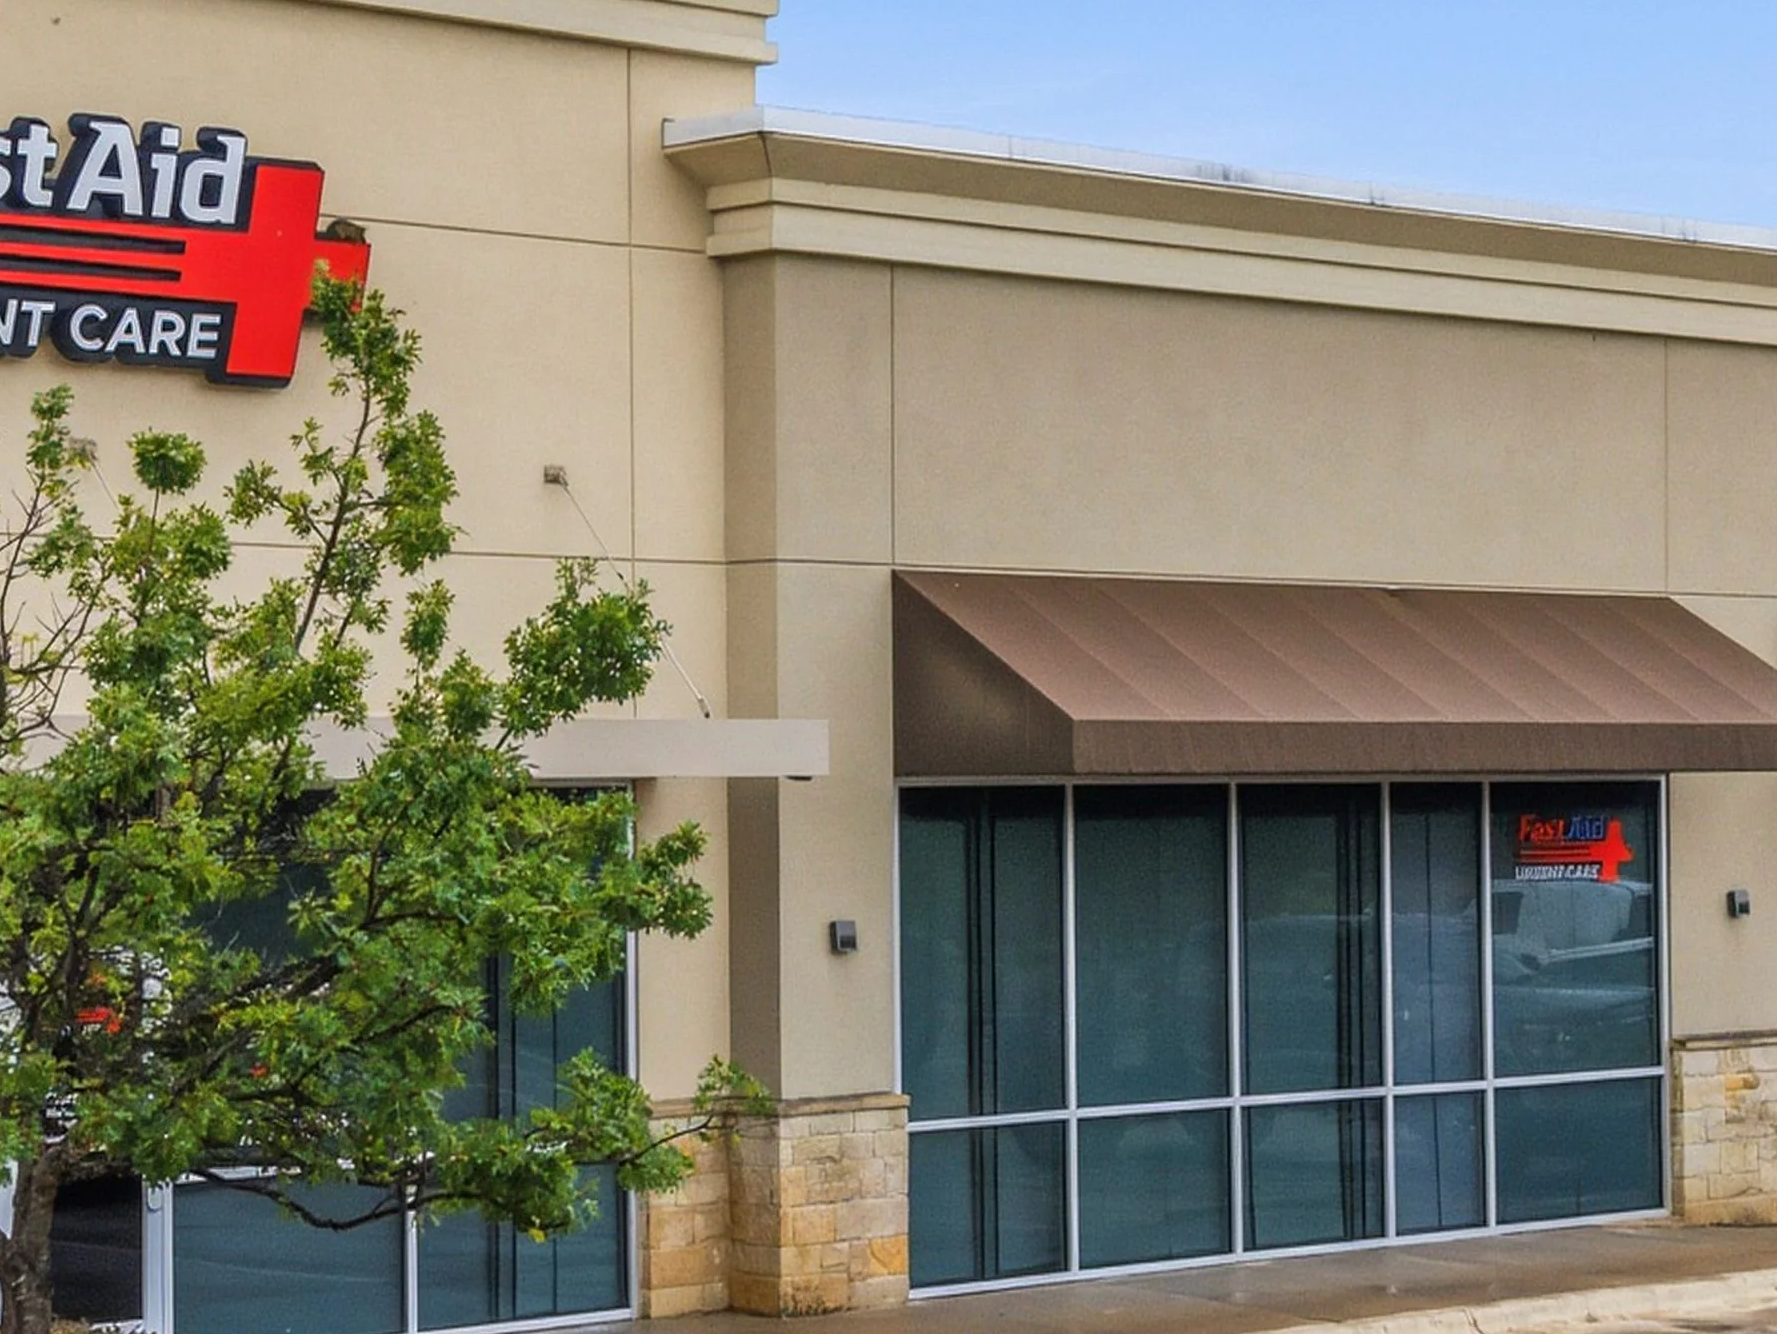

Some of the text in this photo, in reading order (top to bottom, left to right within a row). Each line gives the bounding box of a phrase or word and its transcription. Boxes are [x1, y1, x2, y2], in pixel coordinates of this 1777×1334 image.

[67, 120, 246, 224] Aid
[68, 302, 222, 360] CARE
[1518, 814, 1566, 842] Fast
